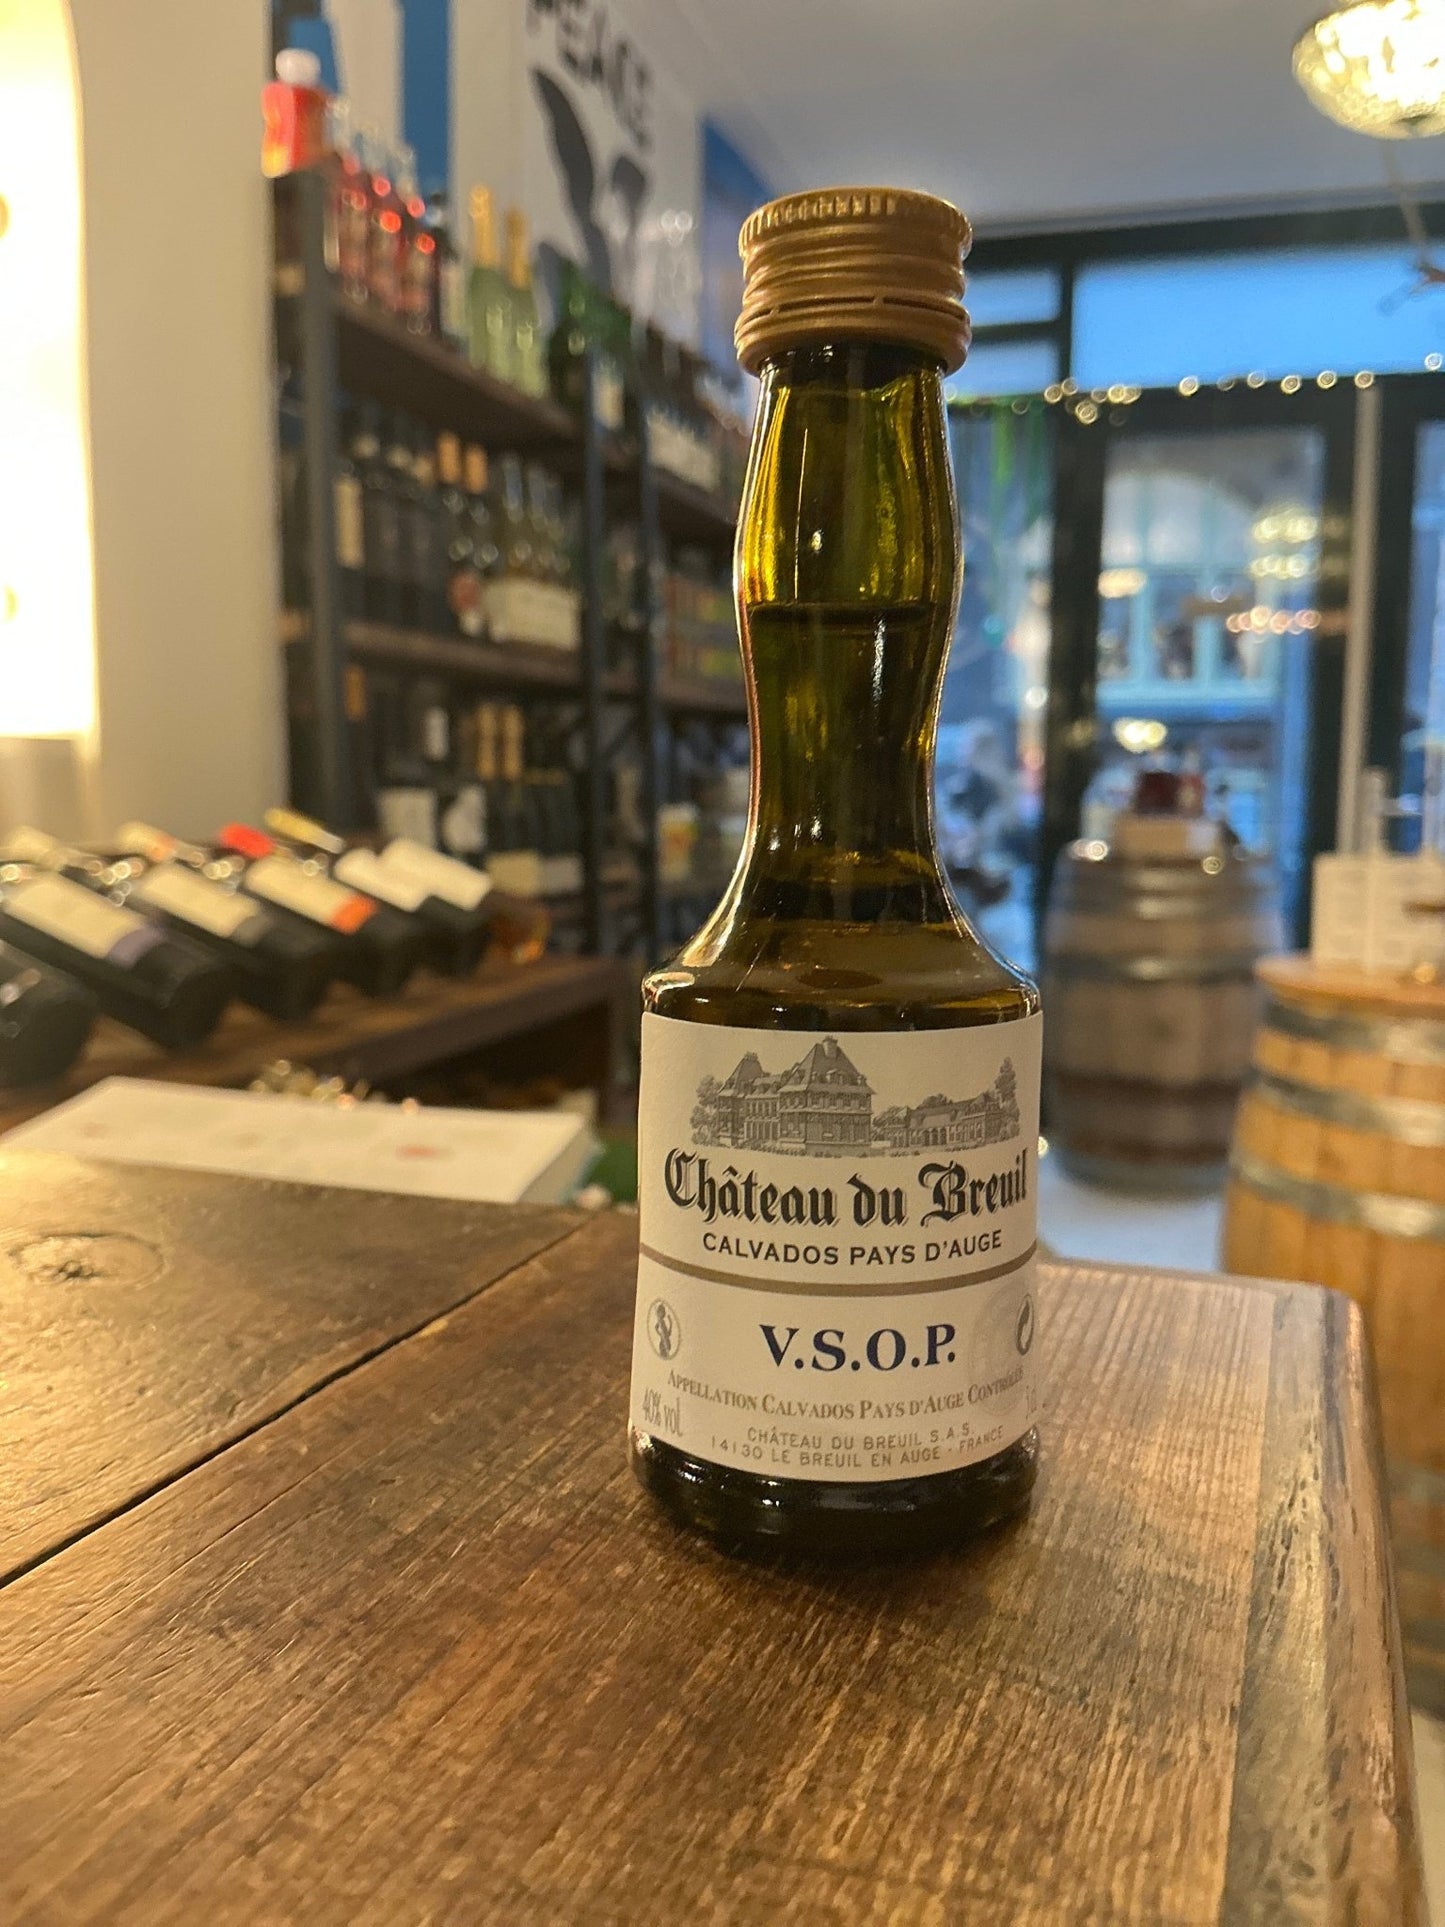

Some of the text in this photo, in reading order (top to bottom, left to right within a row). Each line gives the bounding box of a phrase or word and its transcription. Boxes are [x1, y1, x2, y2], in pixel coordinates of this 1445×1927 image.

[664, 1147, 1028, 1228] Château du Breuil
[702, 1229, 1003, 1266] CALVADOS PAYS D'AUGE
[759, 1323, 956, 1372] V.S.O.P.
[642, 1387, 662, 1426] 40%
[762, 1394, 855, 1421] CALVADOS
[859, 1400, 905, 1421] PAYS
[711, 1435, 764, 1461] 14130
[771, 1449, 791, 1464] LE
[800, 1451, 861, 1468] BREUIL
[871, 1452, 892, 1468] EN
[900, 1447, 941, 1465] AUGE
[959, 1424, 1004, 1454] FRANCE
[747, 1426, 822, 1449] CHÂTEAU
[831, 1436, 855, 1450] DU
[863, 1431, 923, 1451] BREUIL
